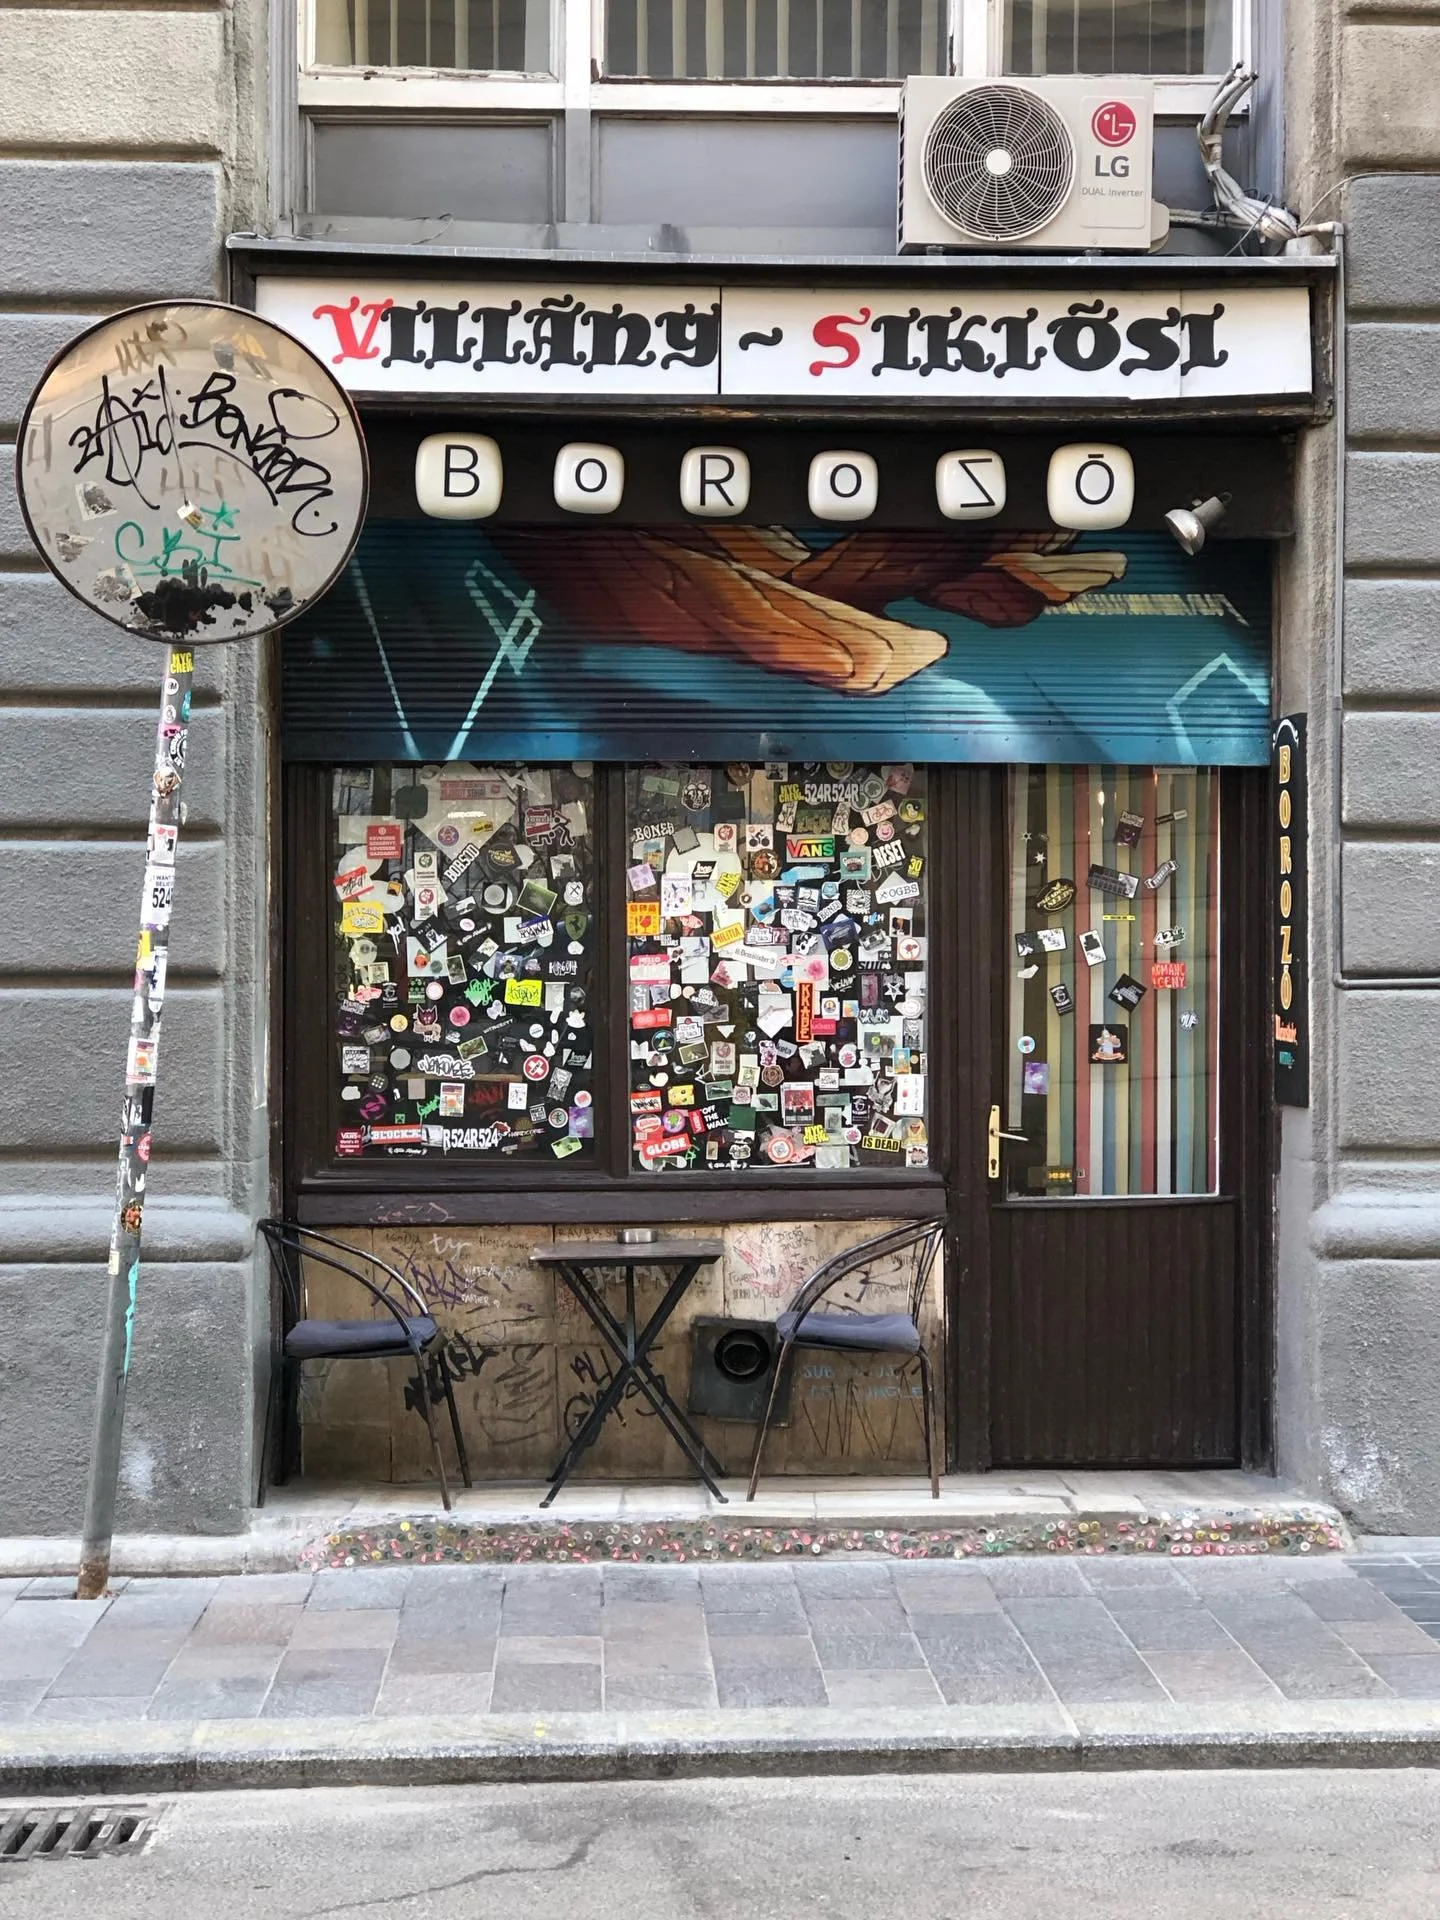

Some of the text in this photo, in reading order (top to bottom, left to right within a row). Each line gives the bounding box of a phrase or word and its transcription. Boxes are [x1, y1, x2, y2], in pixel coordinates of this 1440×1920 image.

[1095, 155, 1130, 177] LG
[1081, 187, 1144, 197] DUAL Inverter
[786, 837, 835, 858] VANS
[872, 839, 906, 869] RESET
[713, 927, 741, 942] MILITIA
[702, 1104, 716, 1115] OFF
[704, 1114, 719, 1123] THE
[706, 1118, 729, 1131] WALL
[646, 1138, 687, 1156] GLOBE
[863, 1137, 899, 1151] IS DEAD
